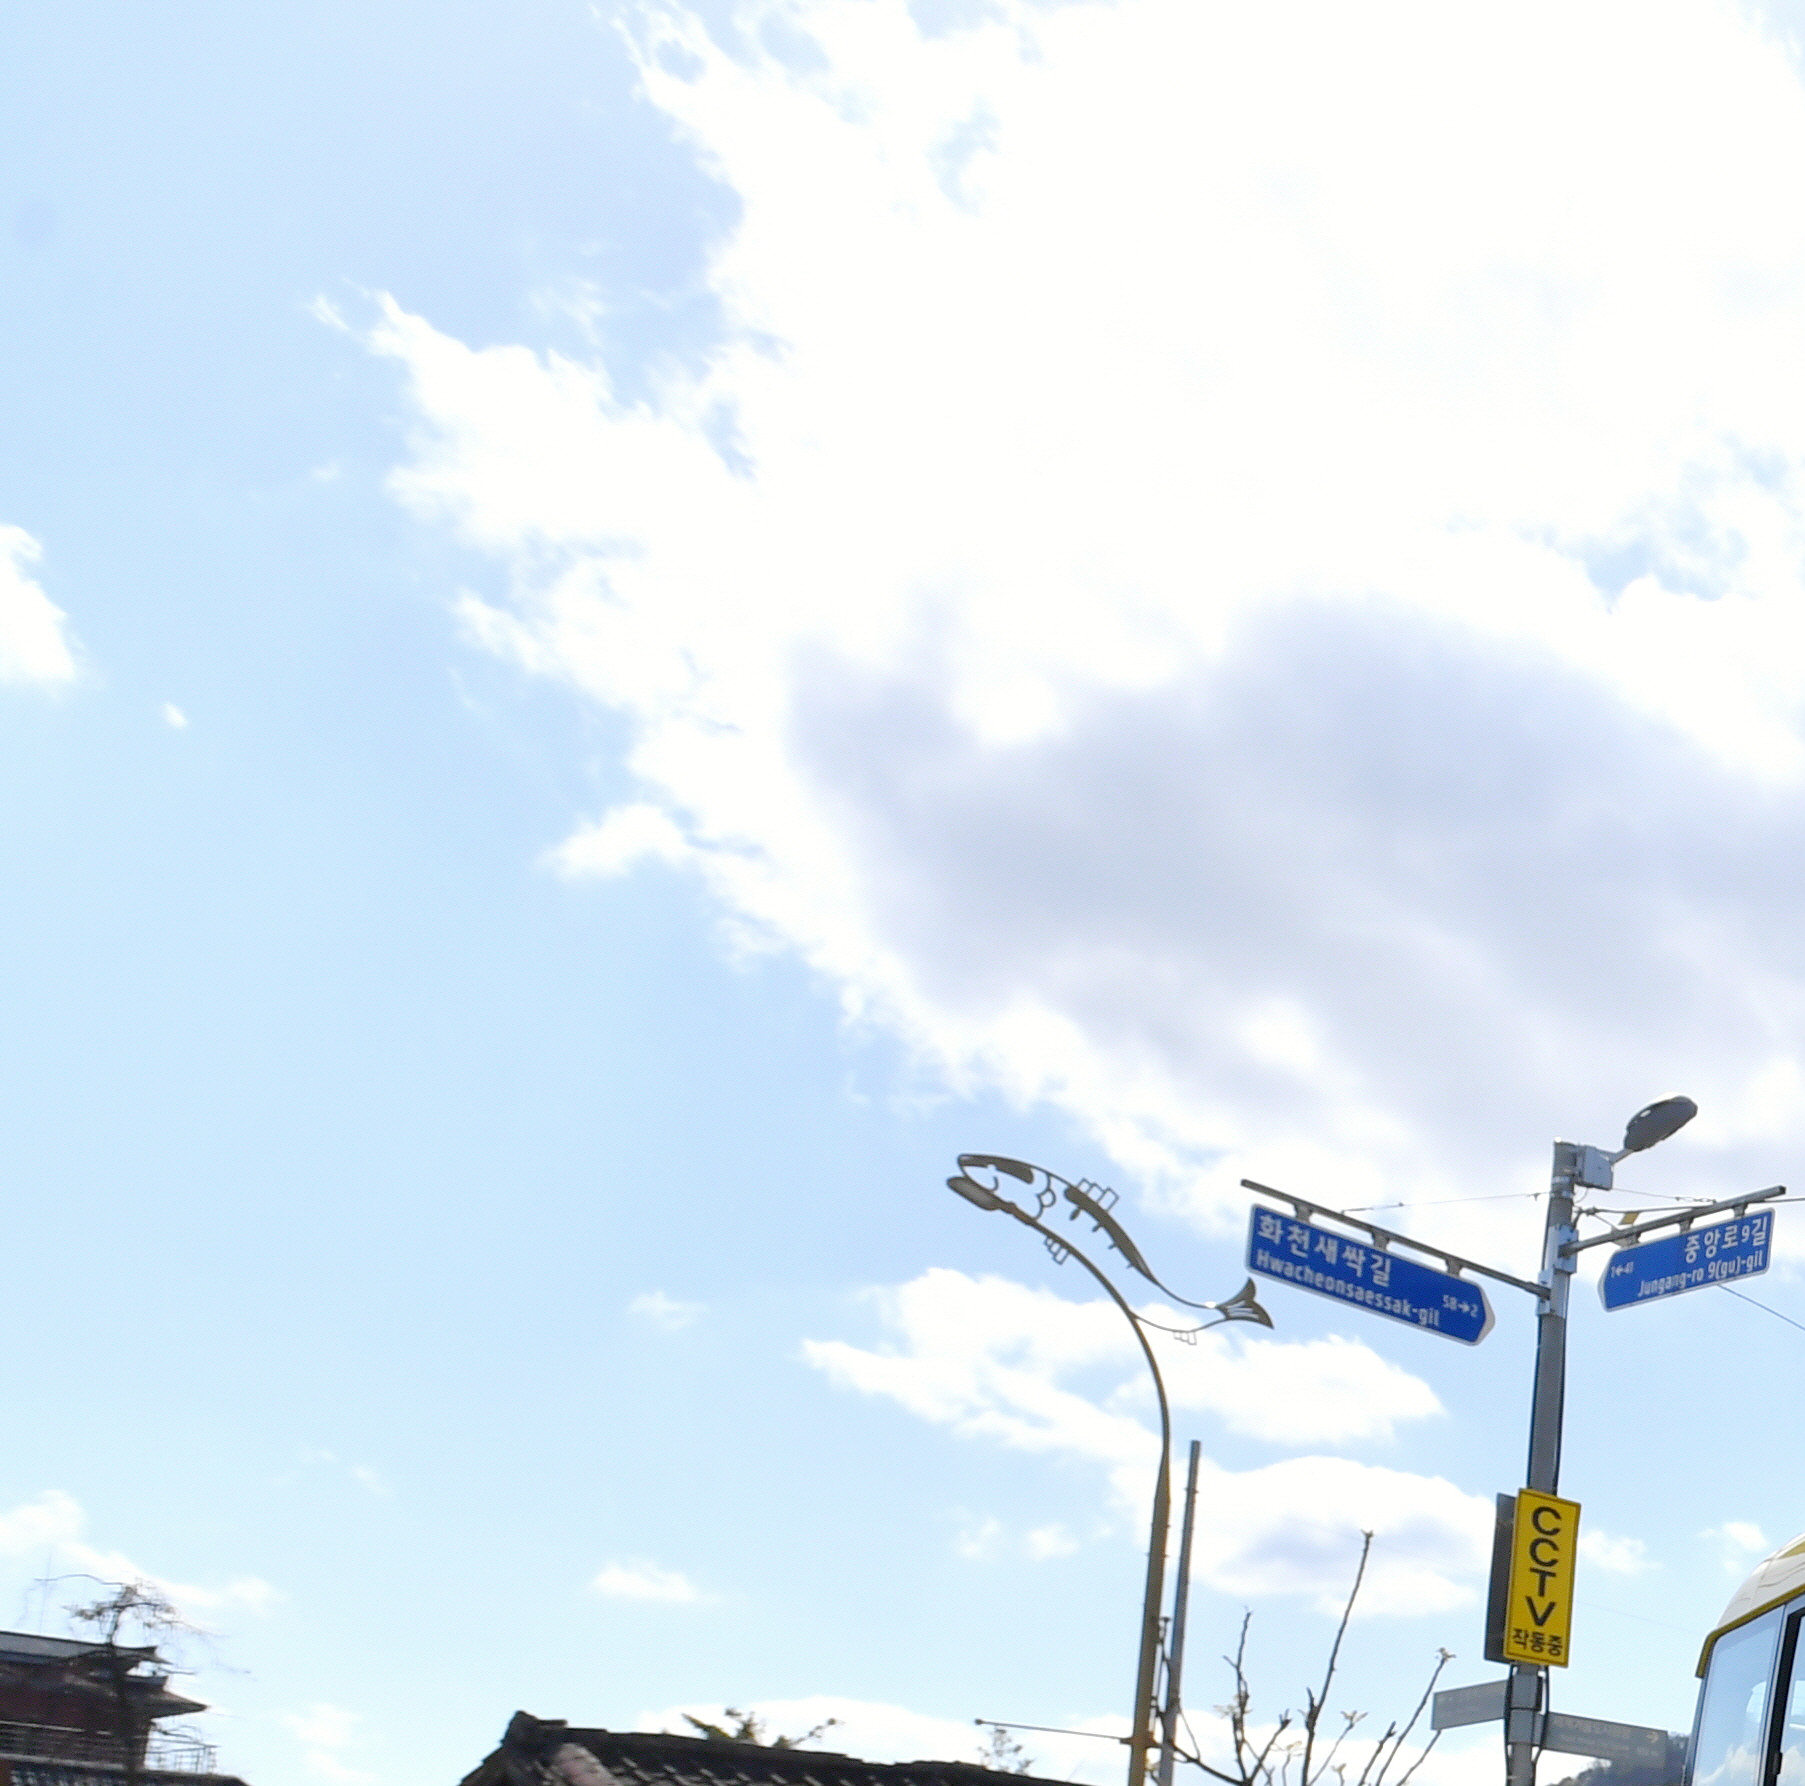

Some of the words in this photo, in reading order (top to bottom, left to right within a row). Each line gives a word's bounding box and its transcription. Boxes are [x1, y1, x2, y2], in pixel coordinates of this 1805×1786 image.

[1257, 1213, 1392, 1288] 화천새싹길
[1684, 1216, 1768, 1264] 중앙로9길
[1255, 1248, 1441, 1328] Hwacheonsaessak-gil
[1637, 1266, 1704, 1298] Jungang-ro
[1707, 1249, 1764, 1281] 9(gu)-gil
[1524, 1506, 1563, 1628] CCTV
[1512, 1627, 1563, 1657] 작동중
